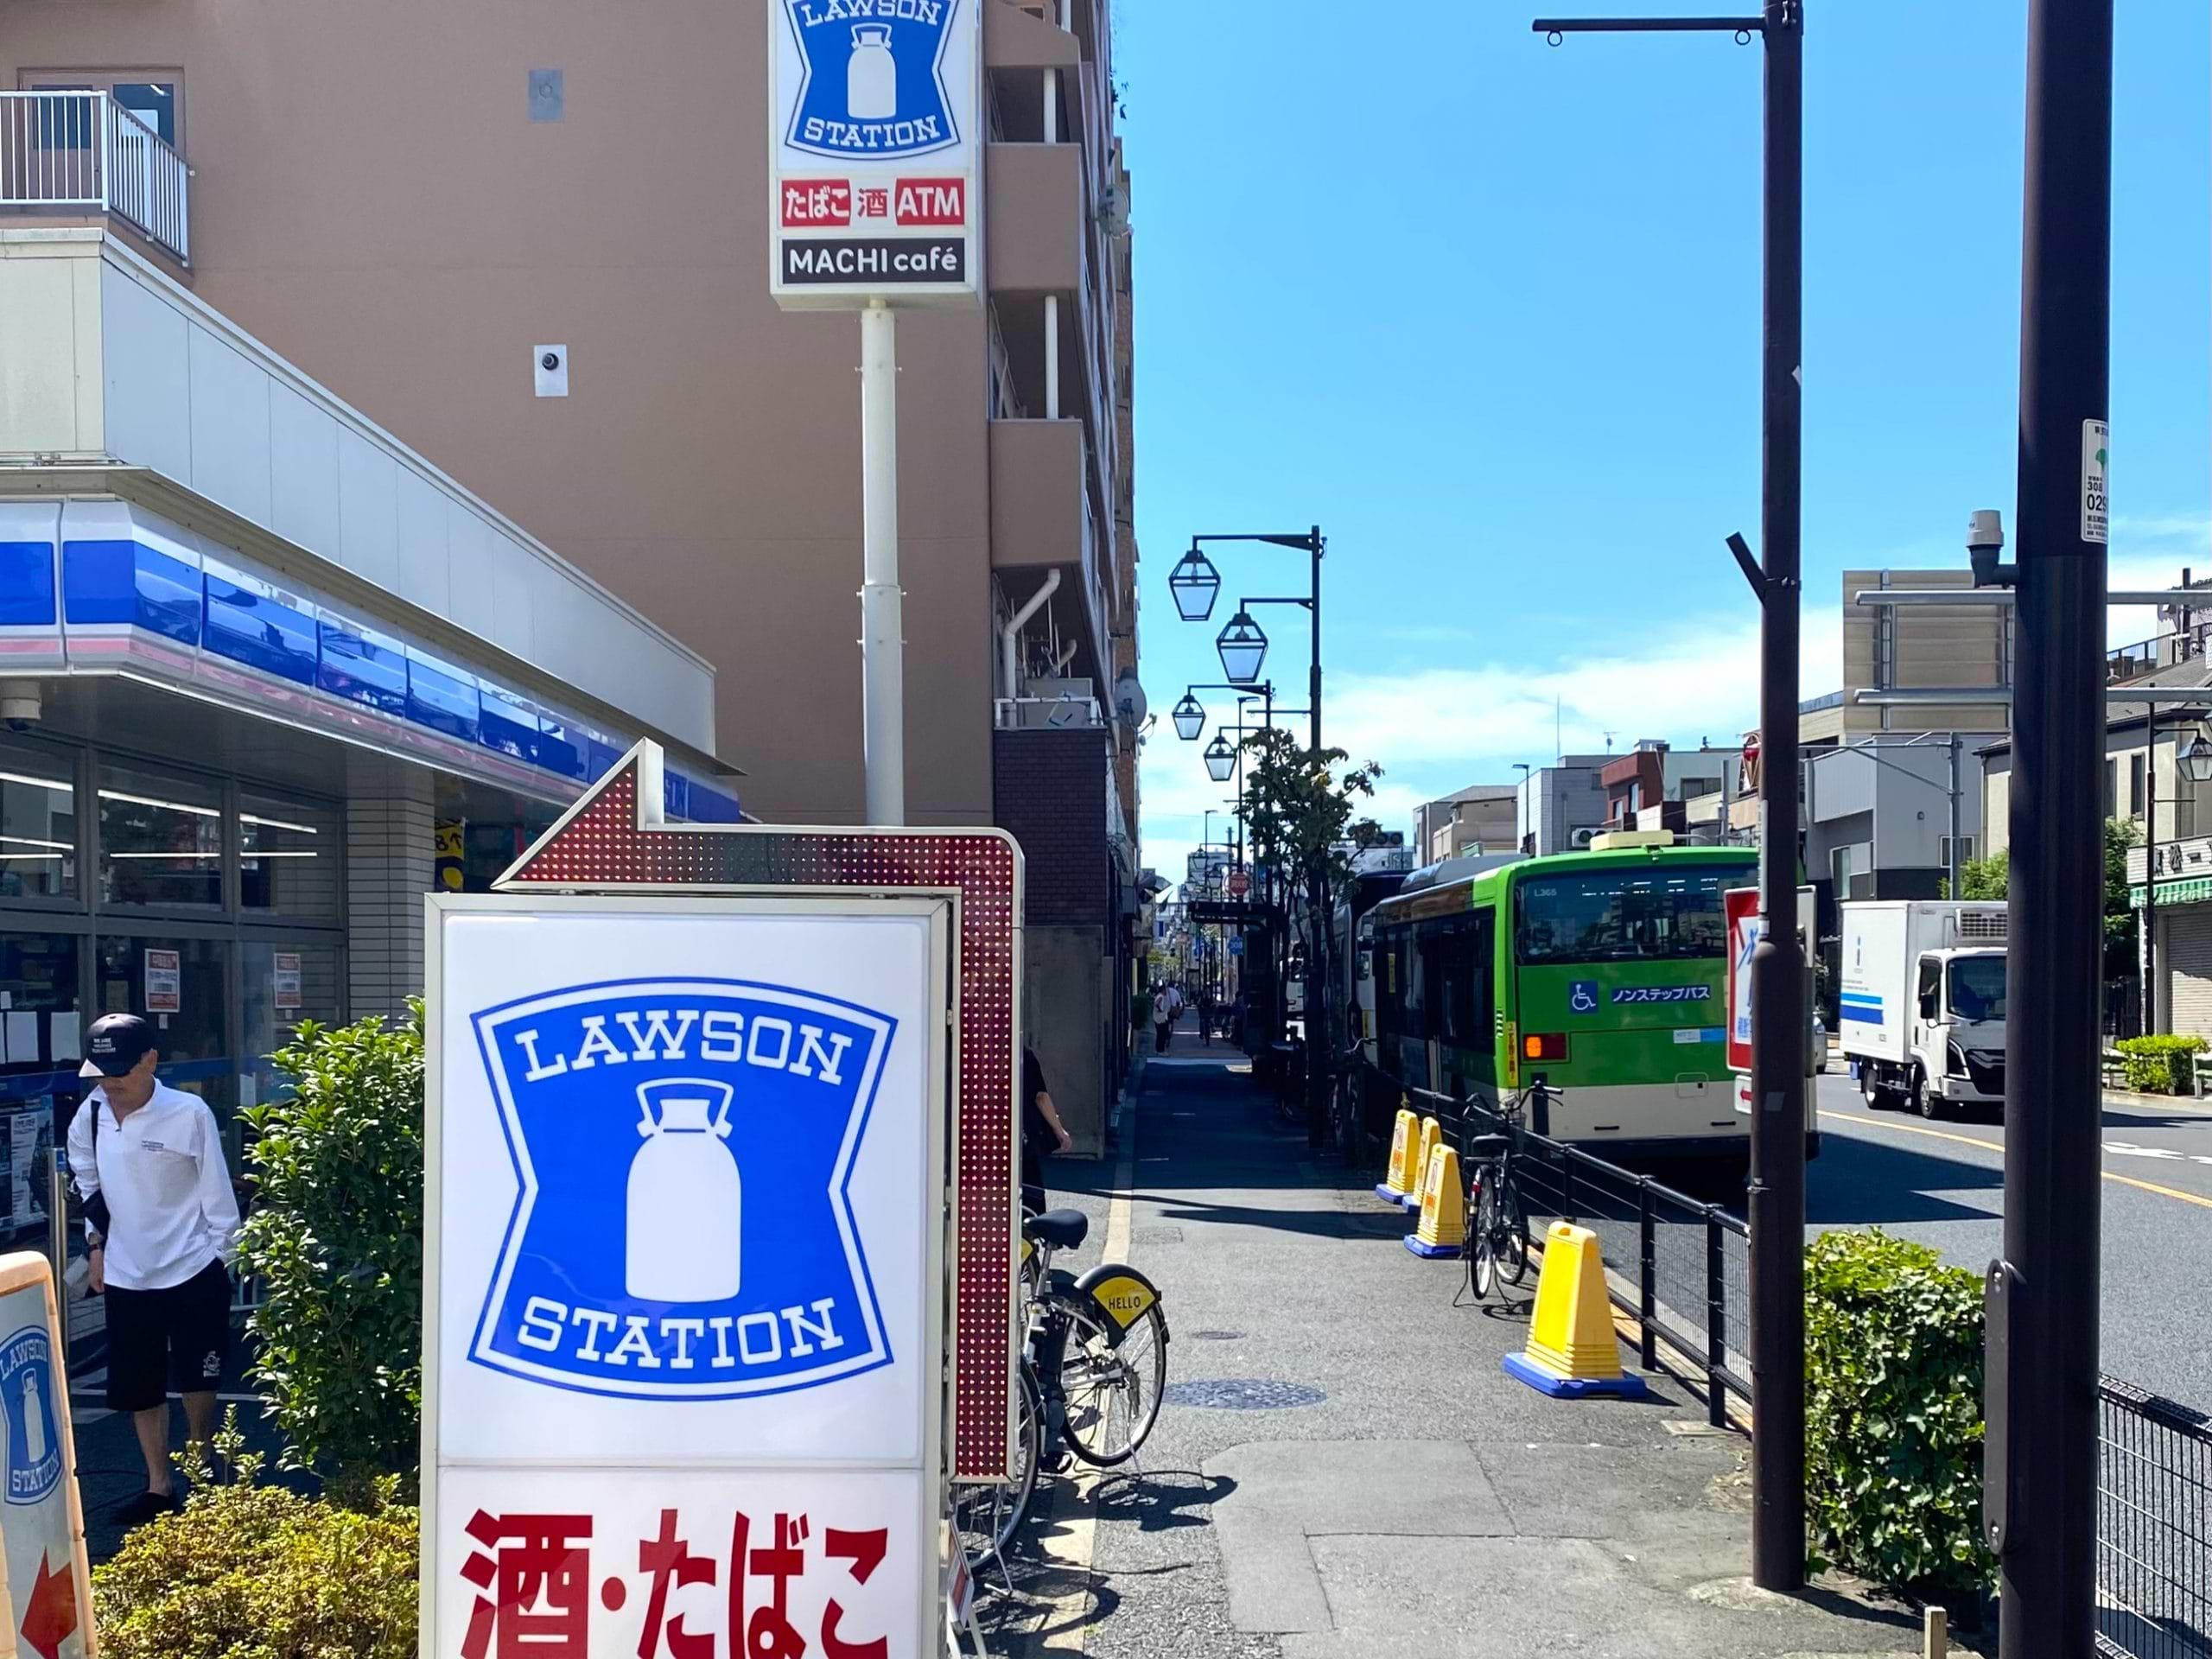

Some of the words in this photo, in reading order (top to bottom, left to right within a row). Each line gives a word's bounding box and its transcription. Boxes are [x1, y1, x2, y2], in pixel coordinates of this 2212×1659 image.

[801, 0, 943, 27] LAWSON
[804, 115, 941, 148] STATION
[785, 185, 850, 219] たばこ
[858, 188, 888, 217] 酒
[897, 187, 961, 217] ATM
[790, 248, 887, 274] MACHI
[893, 246, 957, 272] café
[1612, 986, 1711, 1002] ノンステップバス
[514, 1008, 854, 1085] LAWSON
[1109, 1297, 1141, 1310] HELLO
[517, 1295, 845, 1369] STATION
[0, 1338, 48, 1382] LAWSON
[12, 1447, 61, 1492] STATION
